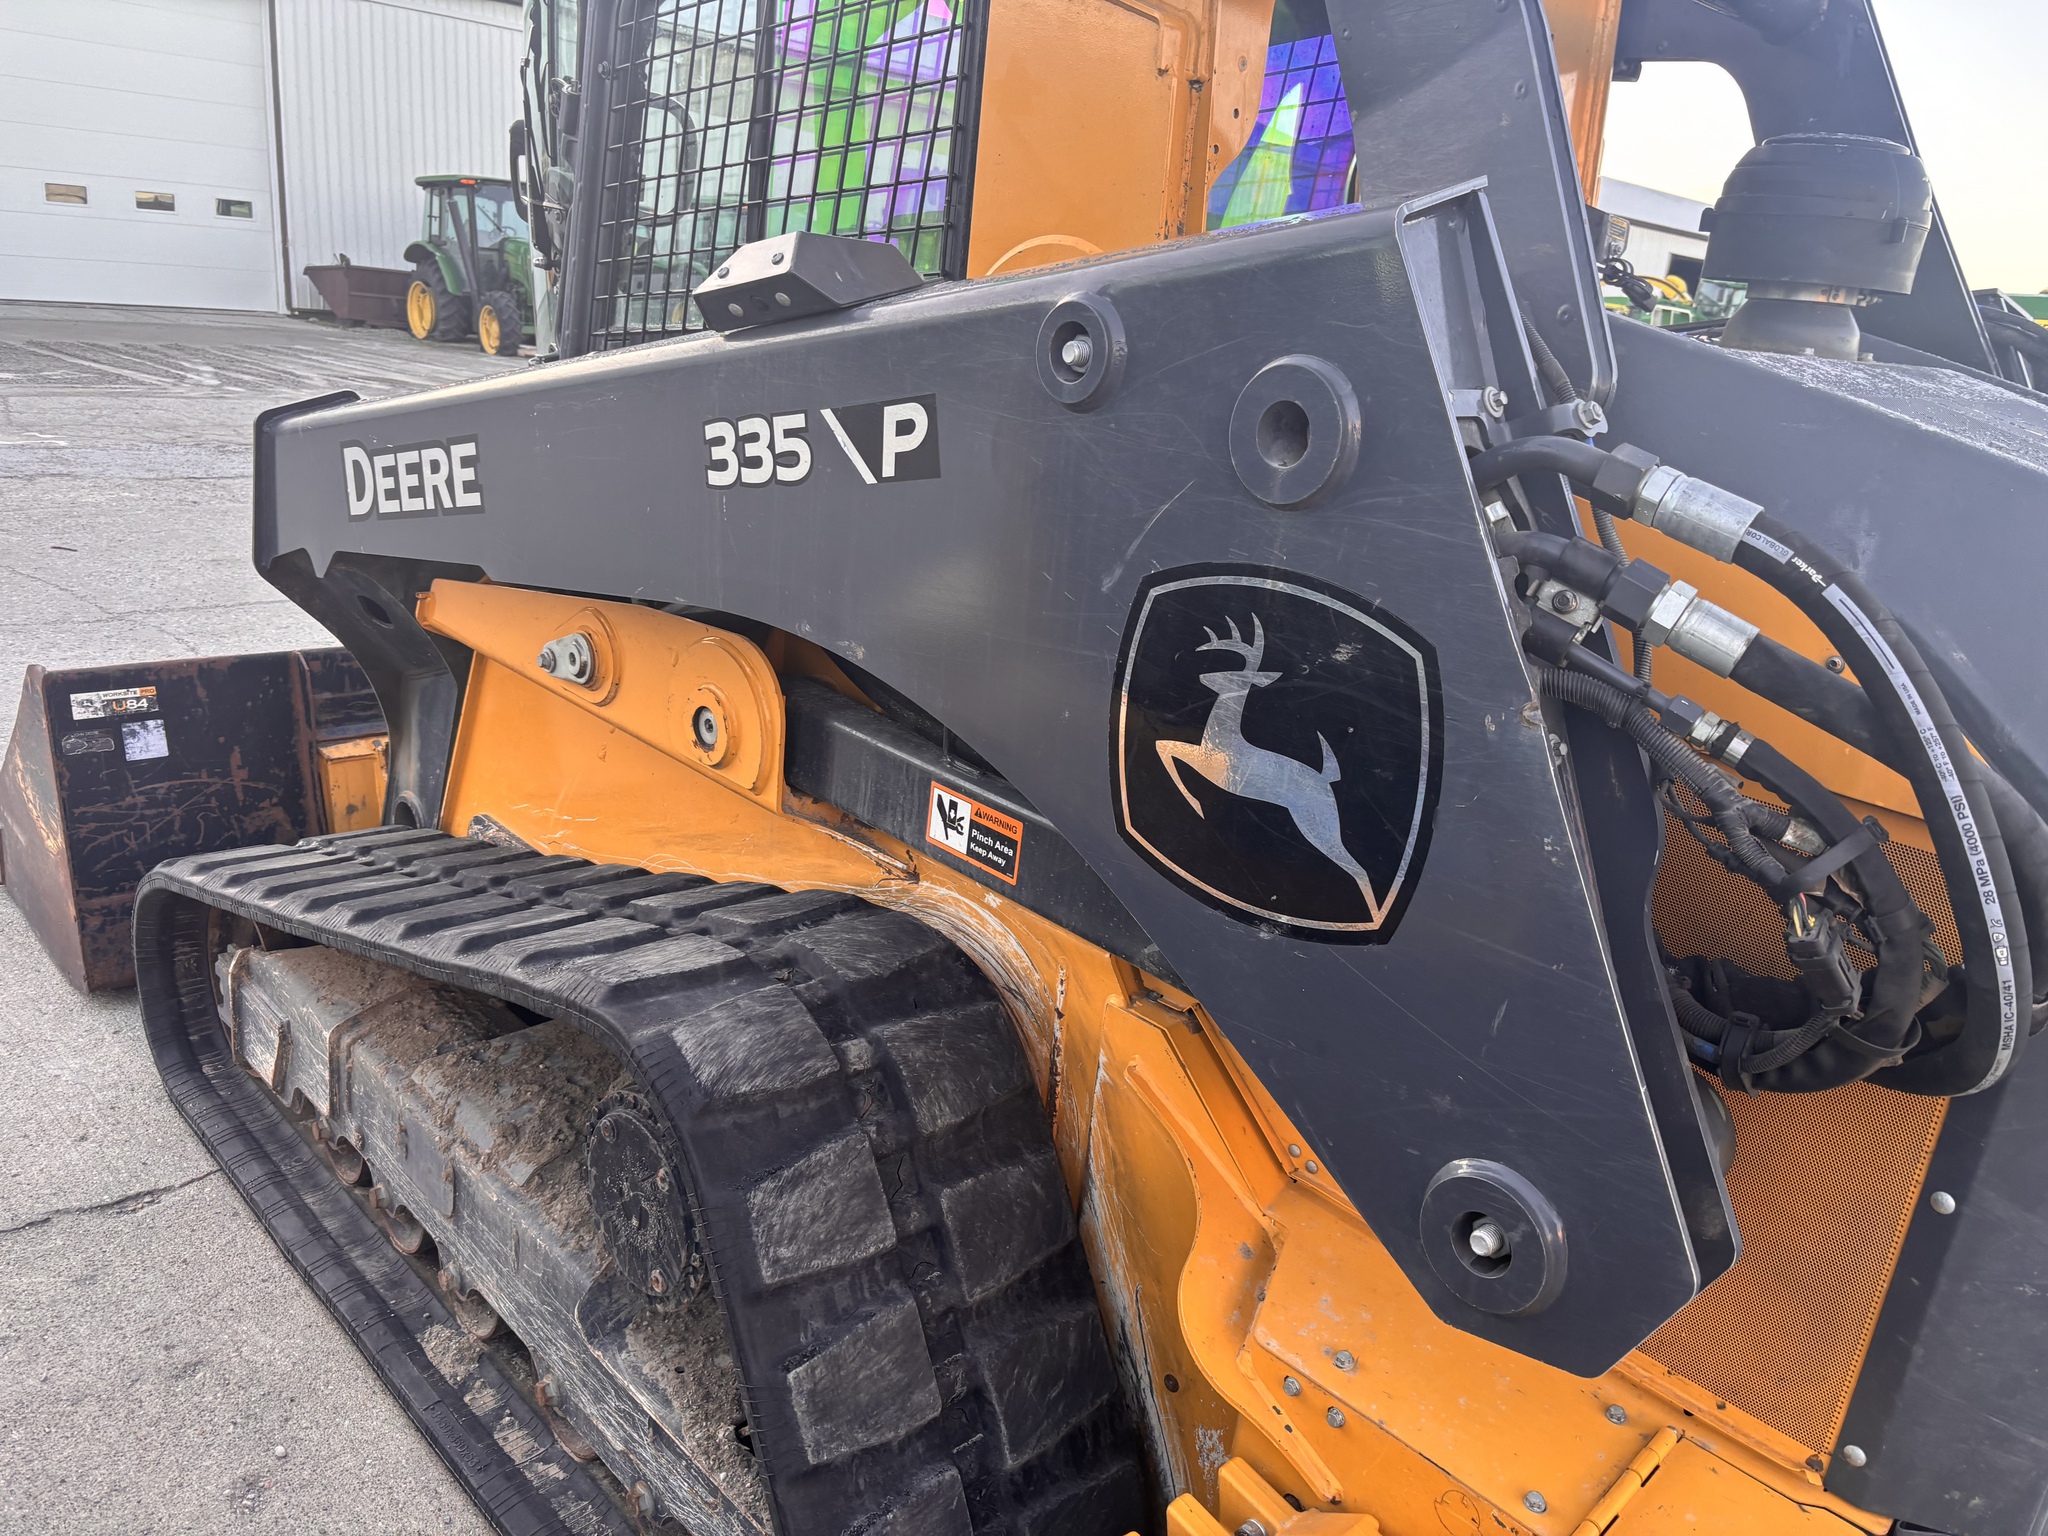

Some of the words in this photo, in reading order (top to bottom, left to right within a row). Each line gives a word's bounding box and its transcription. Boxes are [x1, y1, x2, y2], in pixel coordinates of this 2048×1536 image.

[704, 413, 812, 486] 335
[343, 441, 482, 516] DEERE
[1791, 556, 1826, 587] Parker
[102, 690, 138, 698] WORKSITE
[1901, 682, 1910, 694] USA
[113, 698, 148, 711] U84
[1911, 701, 1921, 715] MADE
[1950, 795, 1970, 821] PSI)
[981, 811, 1018, 835] WARNING
[971, 829, 994, 847] Pinch
[994, 841, 1014, 857] Area
[1962, 823, 1982, 856] (4000
[970, 842, 987, 858] Keep
[987, 851, 1007, 867] Away
[1976, 859, 1992, 887] MPa
[1983, 891, 1996, 905] 28
[2002, 979, 2014, 1022] IC-40/41
[2002, 1024, 2014, 1051] MSHA
